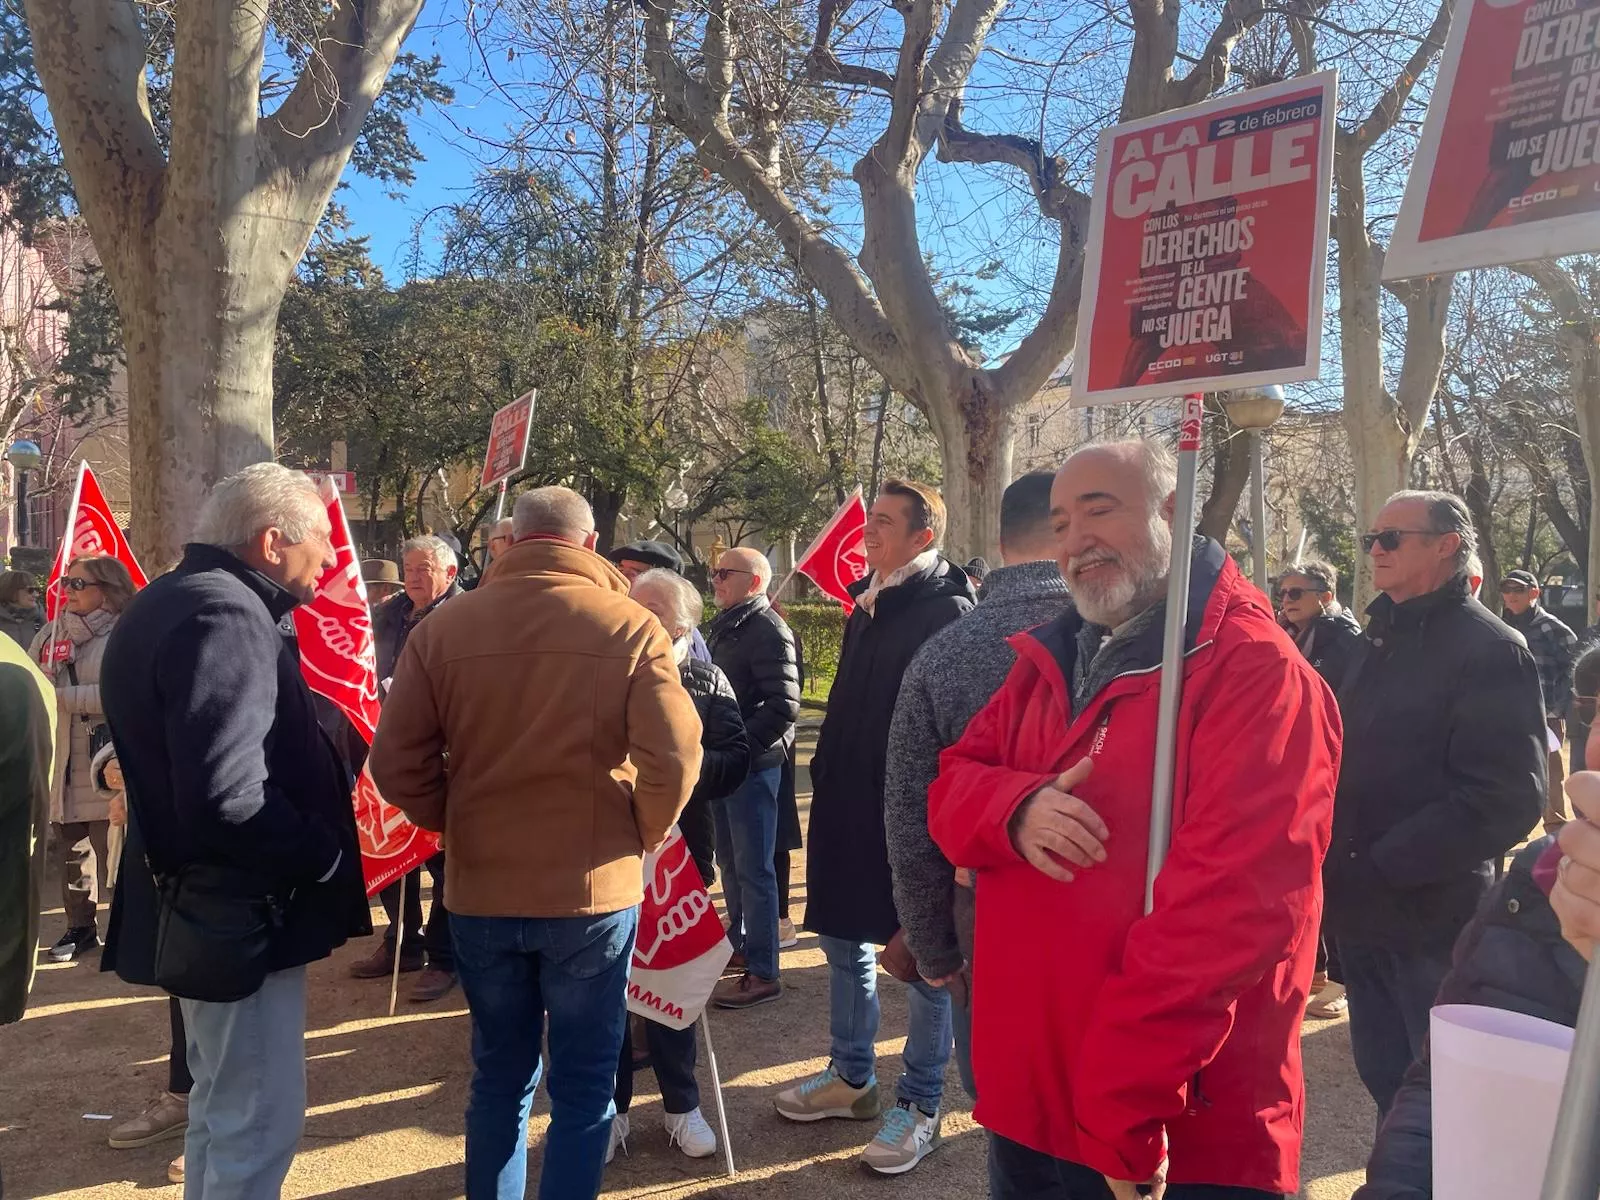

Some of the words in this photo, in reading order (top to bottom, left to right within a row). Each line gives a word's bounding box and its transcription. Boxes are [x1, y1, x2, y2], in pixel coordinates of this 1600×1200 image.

[1524, 0, 1550, 24] CON
[1571, 54, 1590, 76] DE
[1120, 138, 1147, 163] A
[1152, 126, 1200, 155] LA
[1217, 120, 1236, 137] 2
[1240, 116, 1258, 131] de
[1262, 102, 1317, 126] febrero
[1507, 138, 1527, 161] NO
[1527, 134, 1547, 155] SE
[1112, 123, 1314, 220] CALLE
[1508, 189, 1558, 209] CCOO
[1144, 214, 1162, 233] CON
[1163, 213, 1180, 229] LOS
[1141, 216, 1255, 269] DERECHOS
[1181, 262, 1193, 277] DE
[1194, 260, 1205, 273] LA
[1177, 267, 1250, 310] GENTE
[1141, 317, 1155, 334] NO
[1156, 315, 1168, 331] SE
[1159, 305, 1233, 349] JUEGA
[1148, 358, 1182, 371] CCOO
[1205, 352, 1228, 363] UGT
